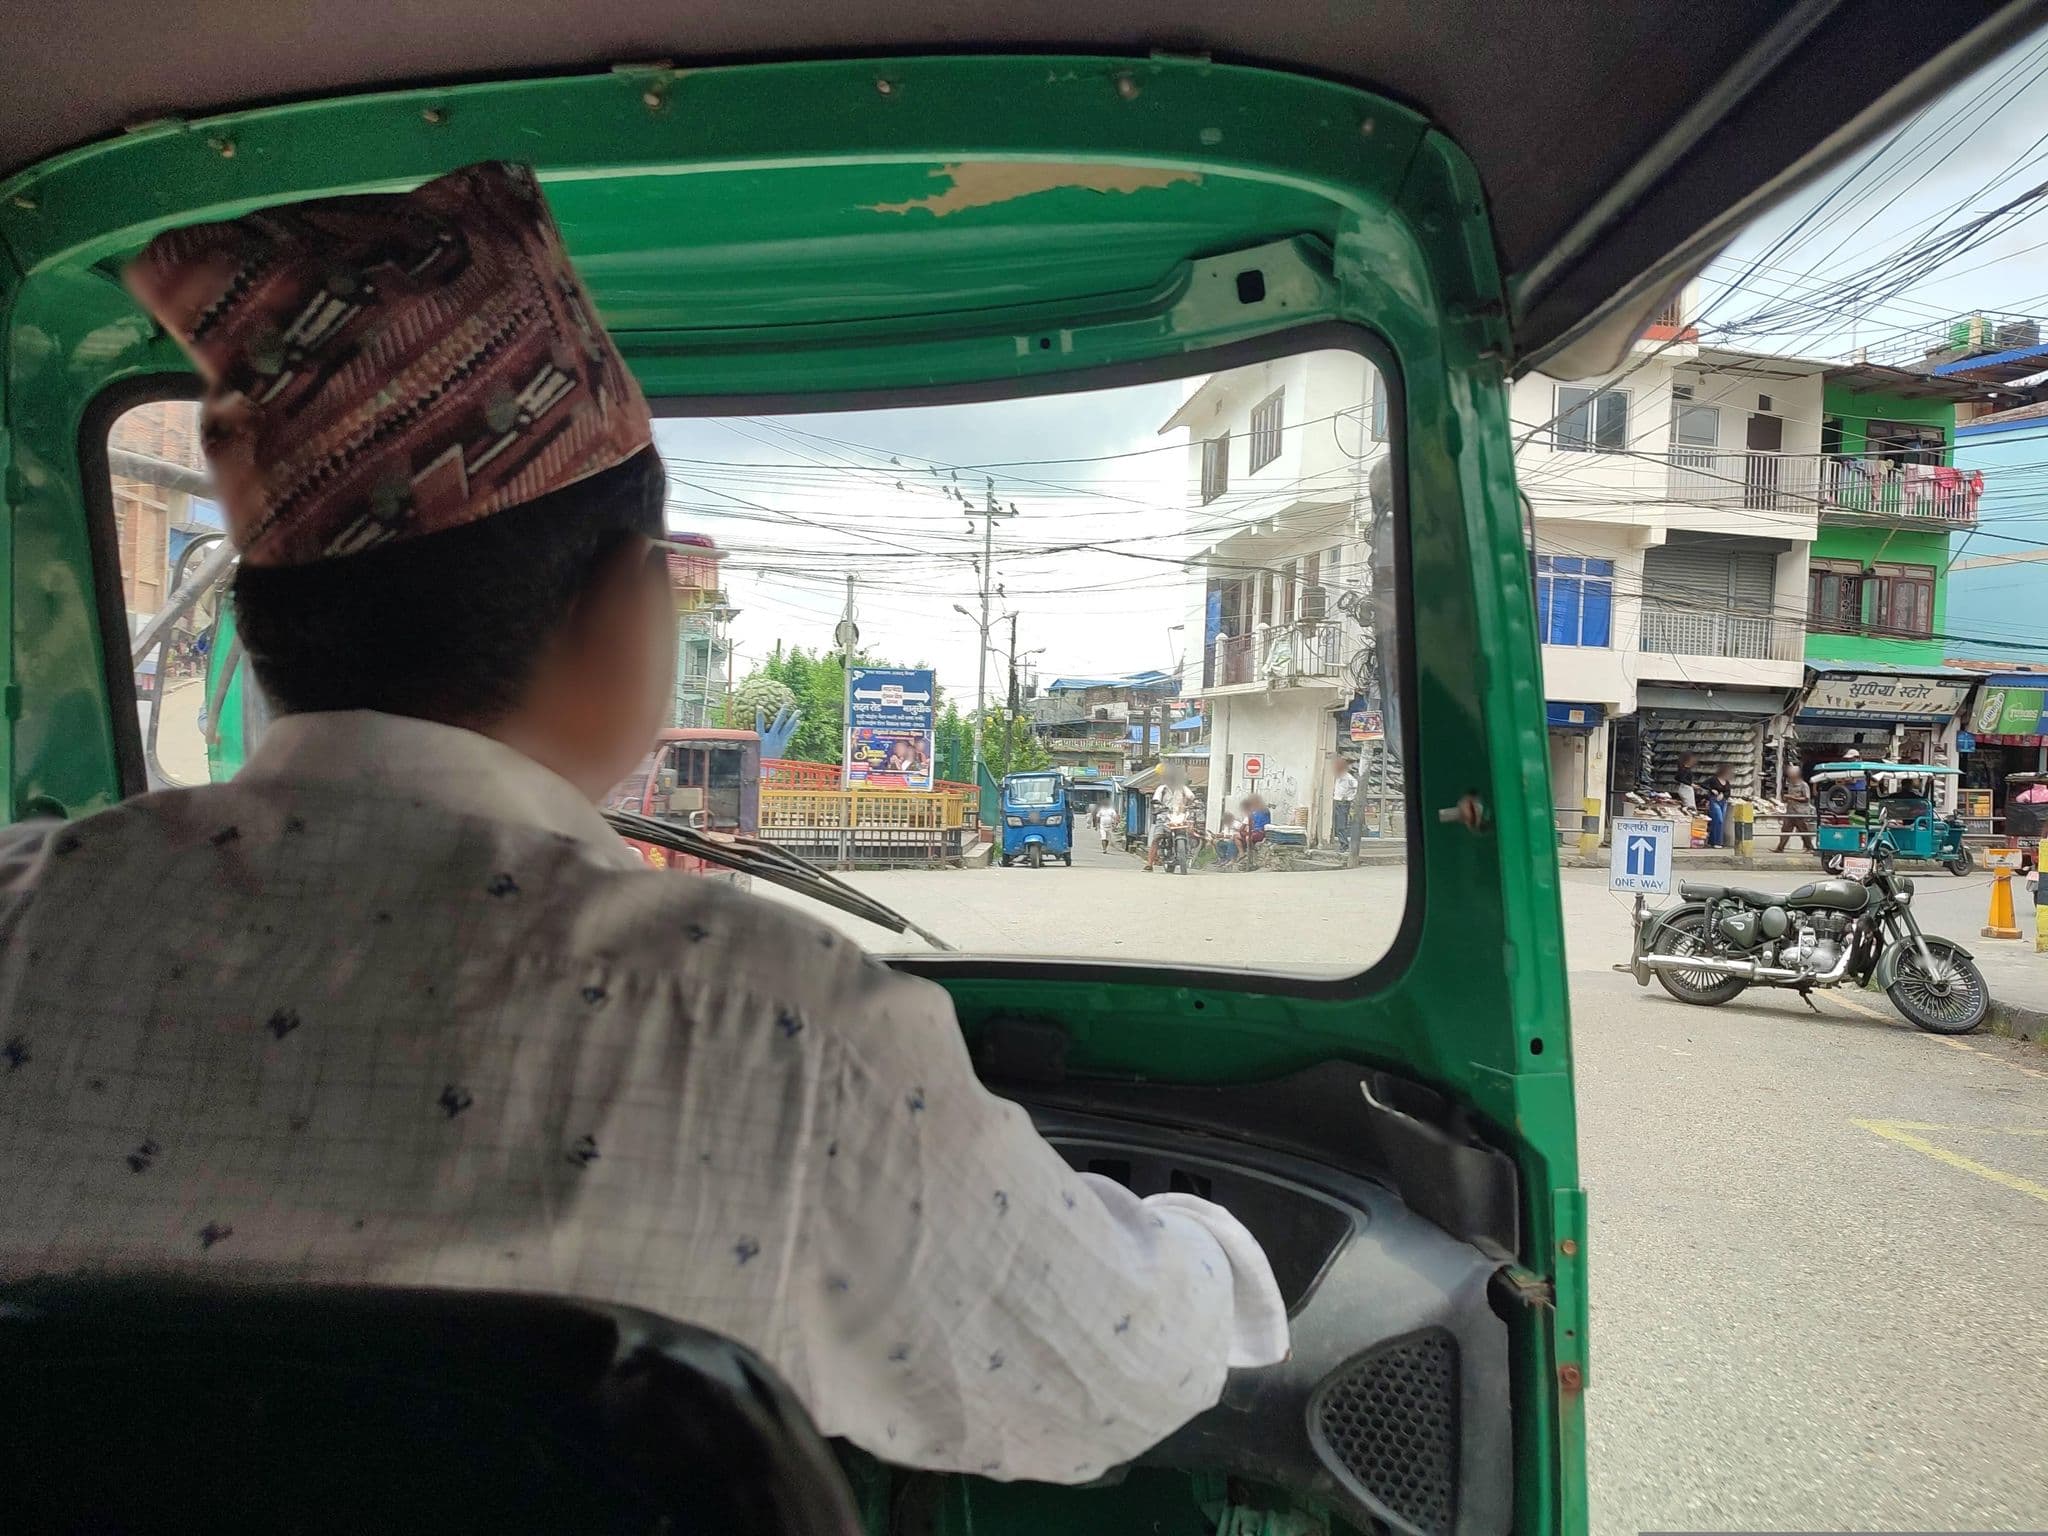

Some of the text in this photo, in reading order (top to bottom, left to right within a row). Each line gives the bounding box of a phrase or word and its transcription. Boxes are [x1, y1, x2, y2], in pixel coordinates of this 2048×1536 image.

[1849, 682, 1895, 698] सुप्रिया
[1900, 684, 1933, 699] स्टोर
[1615, 878, 1664, 889] ONE WAY
